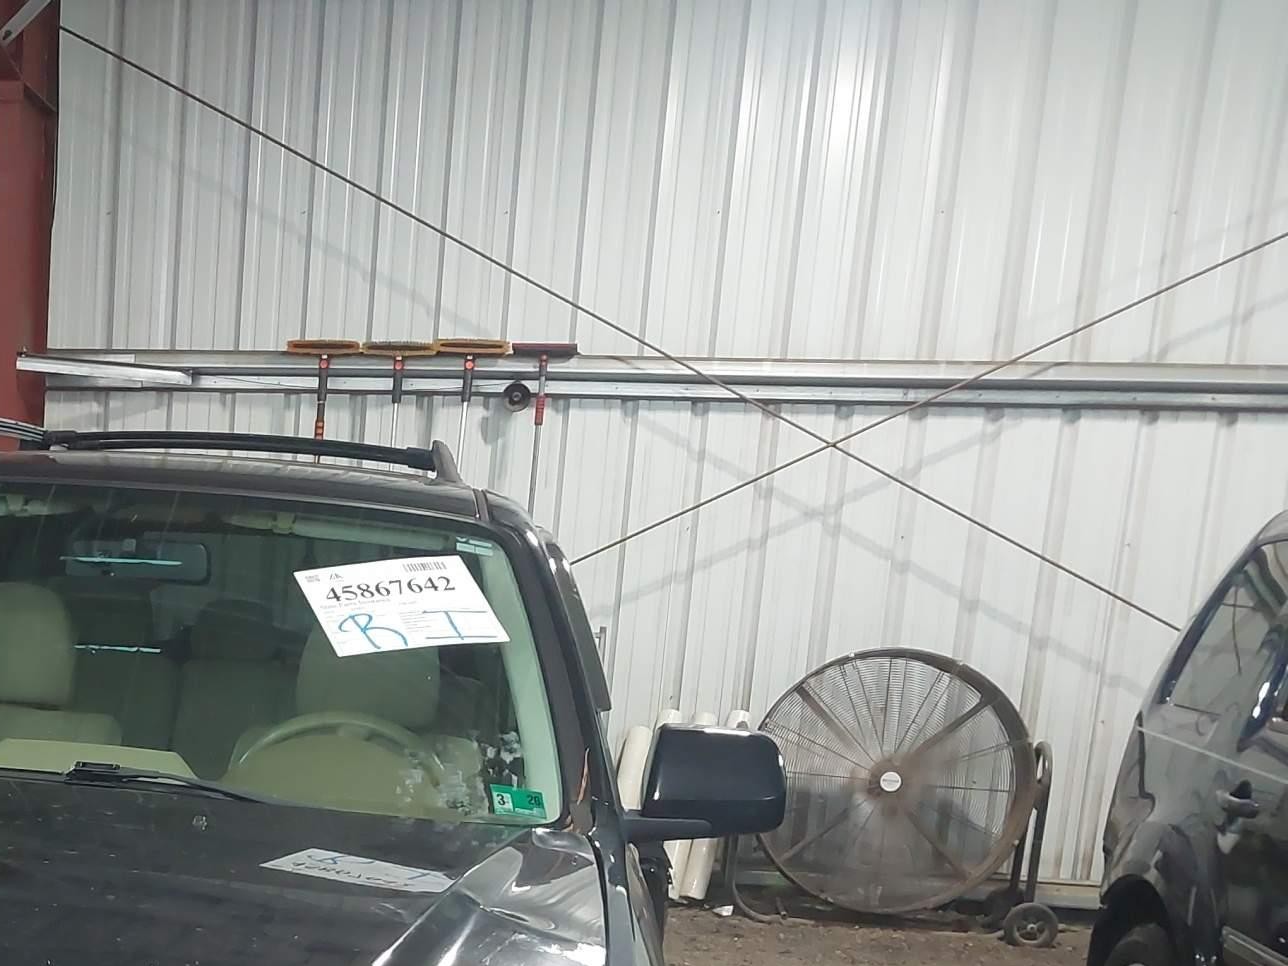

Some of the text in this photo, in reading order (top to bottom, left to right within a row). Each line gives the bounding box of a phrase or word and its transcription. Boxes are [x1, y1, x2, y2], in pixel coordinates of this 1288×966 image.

[325, 576, 456, 602] 45867642
[338, 612, 409, 650] R
[496, 793, 507, 806] 3
